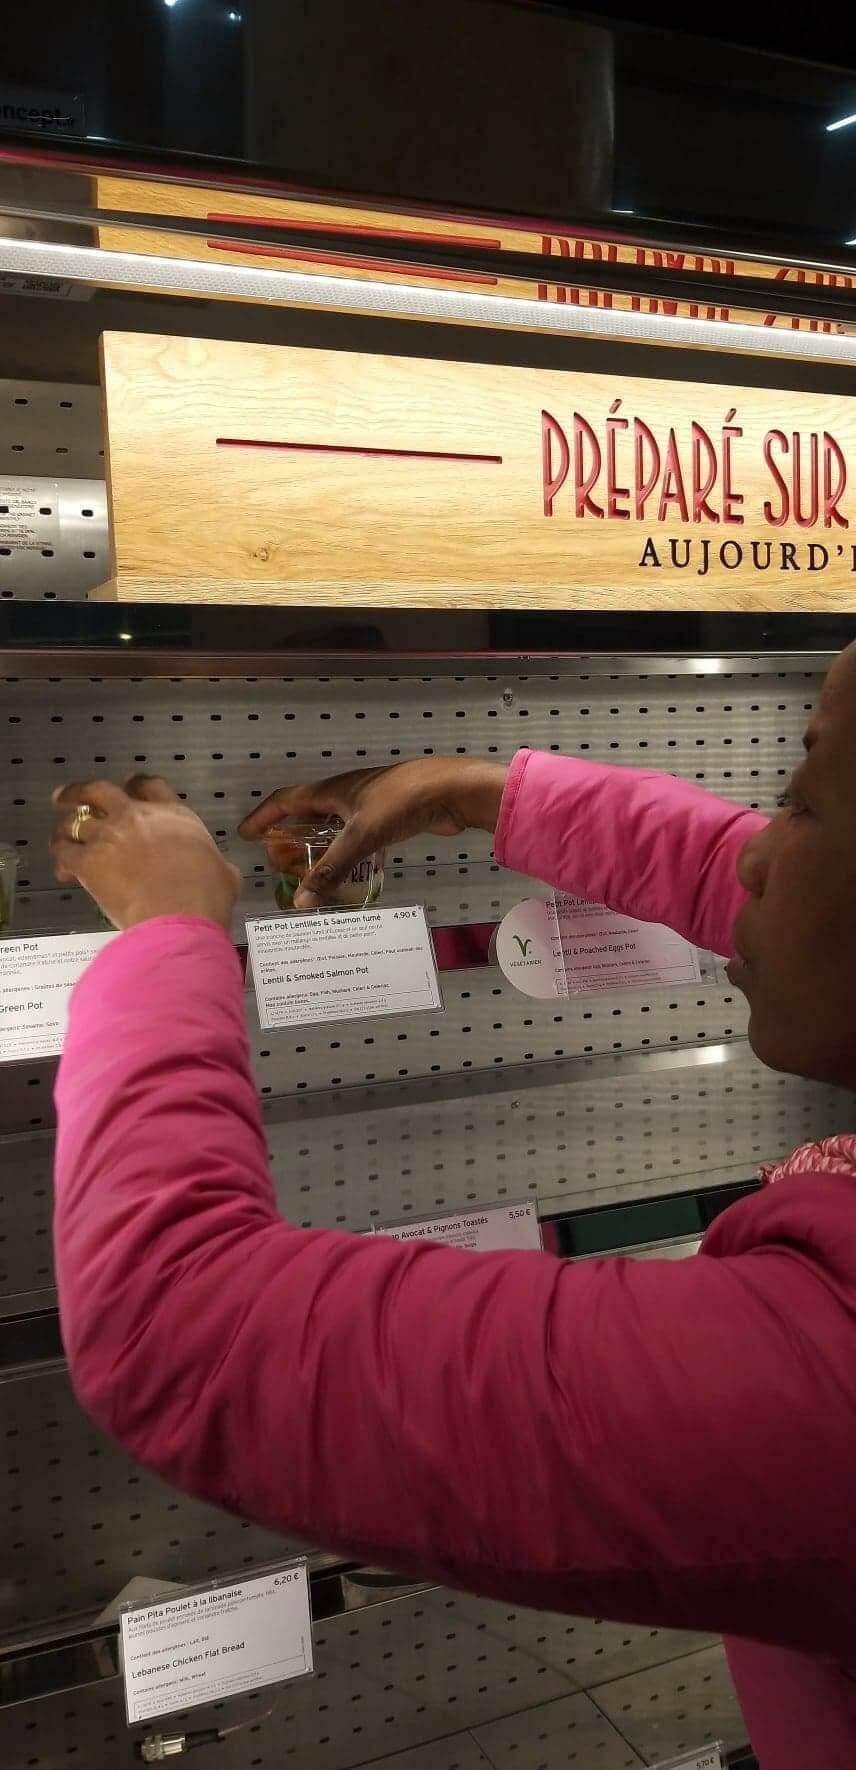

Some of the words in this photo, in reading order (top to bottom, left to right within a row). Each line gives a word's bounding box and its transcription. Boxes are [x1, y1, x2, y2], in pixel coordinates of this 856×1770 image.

[0, 104, 61, 128] ncept
[541, 398, 744, 526] PRÉPARÉ
[763, 429, 849, 529] SUR
[564, 898, 575, 906] Pot
[254, 924, 272, 932] Petit
[275, 922, 288, 931] Pot
[290, 919, 322, 929] Lentilles
[331, 916, 360, 925] Saumon
[362, 914, 381, 923] fumé
[412, 910, 417, 918] €
[0, 945, 21, 953] reen
[23, 943, 38, 951] Pot
[580, 945, 607, 954] Poached
[608, 943, 623, 953] Eggs
[625, 942, 636, 950] Pot
[262, 975, 284, 985] Lentil
[287, 974, 292, 982] &
[295, 971, 324, 981] Smoked
[326, 967, 354, 978] Salmon
[356, 966, 368, 975] Pot
[28, 1002, 43, 1010] Pot
[401, 1228, 425, 1238] Avocat
[434, 1222, 461, 1234] Pignons
[463, 1217, 488, 1228] Toastés
[127, 1614, 145, 1624] Pain
[148, 1609, 163, 1619] Pita
[166, 1602, 190, 1614] Poulet
[193, 1600, 198, 1608] à
[200, 1598, 206, 1606] la
[208, 1589, 242, 1604] libanaise
[132, 1662, 170, 1678] Lebanese
[173, 1653, 203, 1668] Chicken
[205, 1648, 220, 1659] Flat
[222, 1642, 245, 1654] Bread
